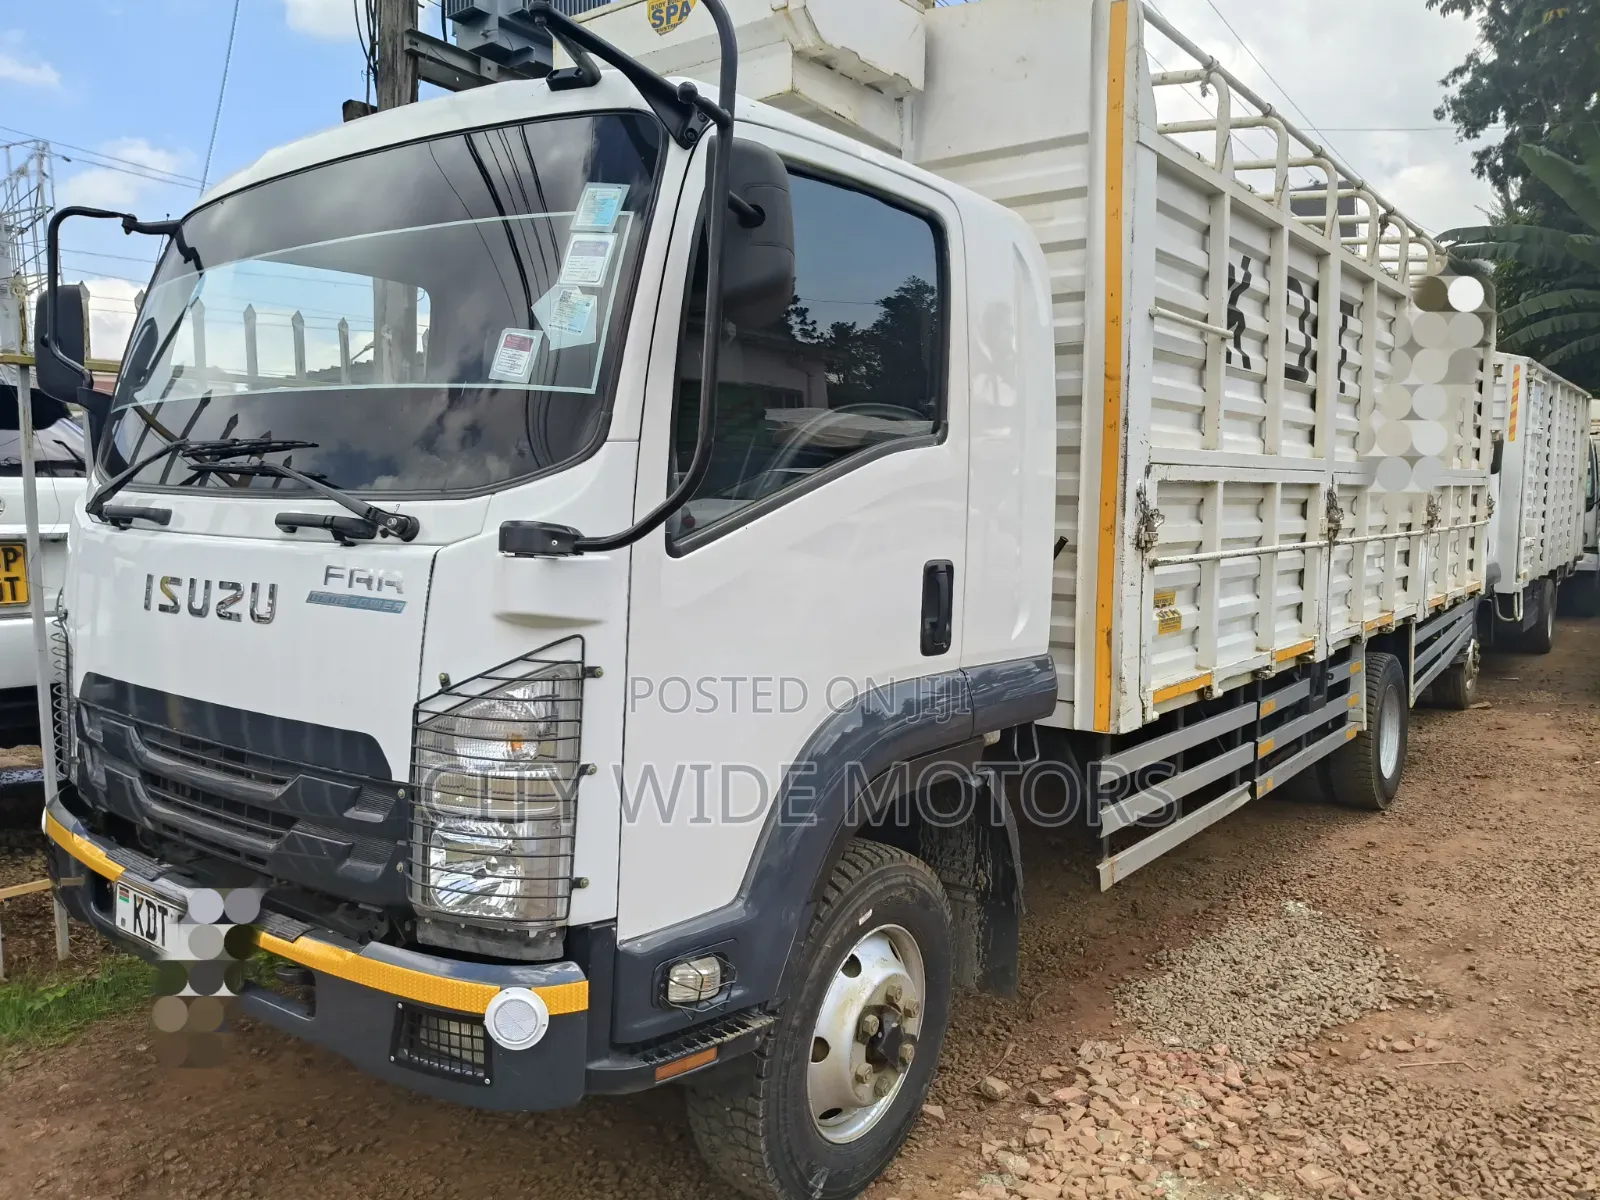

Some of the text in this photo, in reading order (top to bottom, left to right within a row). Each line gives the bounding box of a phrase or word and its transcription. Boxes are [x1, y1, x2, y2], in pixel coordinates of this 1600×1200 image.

[650, 1, 666, 10] BODY
[651, 0, 692, 29] SPA
[0, 546, 22, 573] P
[323, 564, 405, 595] FRR
[143, 573, 279, 625] ISUZU
[133, 893, 169, 947] KDT
